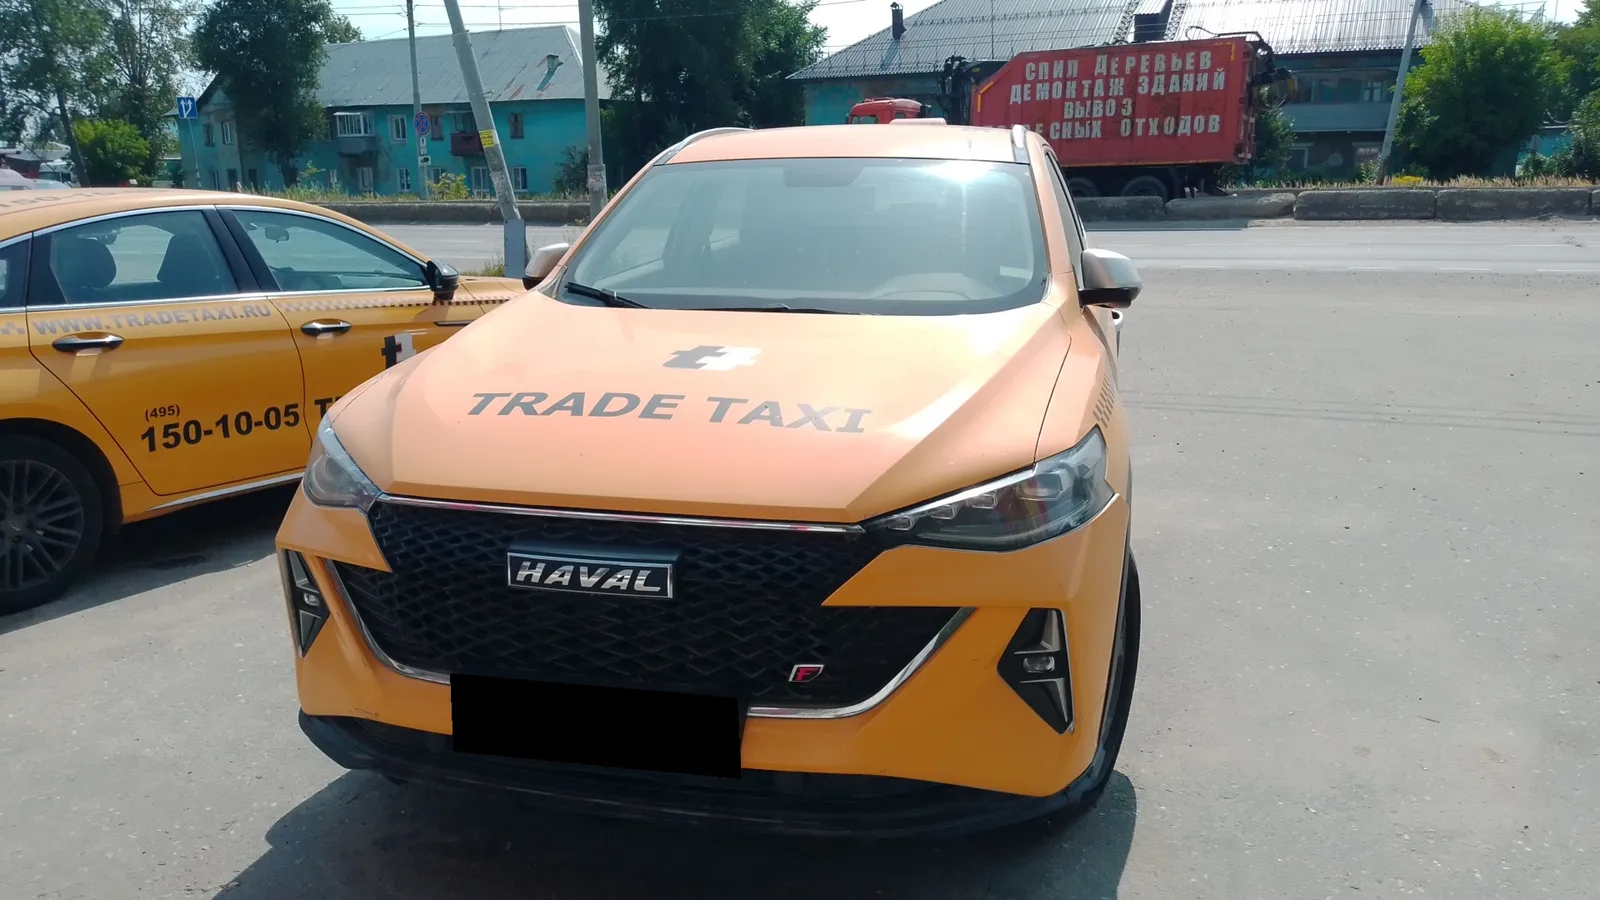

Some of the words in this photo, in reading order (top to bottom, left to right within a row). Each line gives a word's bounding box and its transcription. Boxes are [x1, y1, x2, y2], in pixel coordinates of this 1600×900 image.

[1025, 59, 1078, 81] СПИЛ
[1094, 51, 1212, 77] ДЕРЕВЬЕВ
[1010, 77, 1124, 105] ДЕМОНТАЖ
[1138, 68, 1225, 96] ЗДАНИЙ
[1064, 98, 1133, 119] ВЫВОЗ
[1120, 114, 1221, 137] ОТХОДОВ
[32, 303, 272, 335] WWW.TRADETAXI.RU
[141, 403, 300, 453] 150-10-05
[144, 404, 181, 422] (495)
[467, 392, 686, 420] TRADE
[706, 396, 872, 434] TAXI
[515, 561, 662, 593] HAVAL
